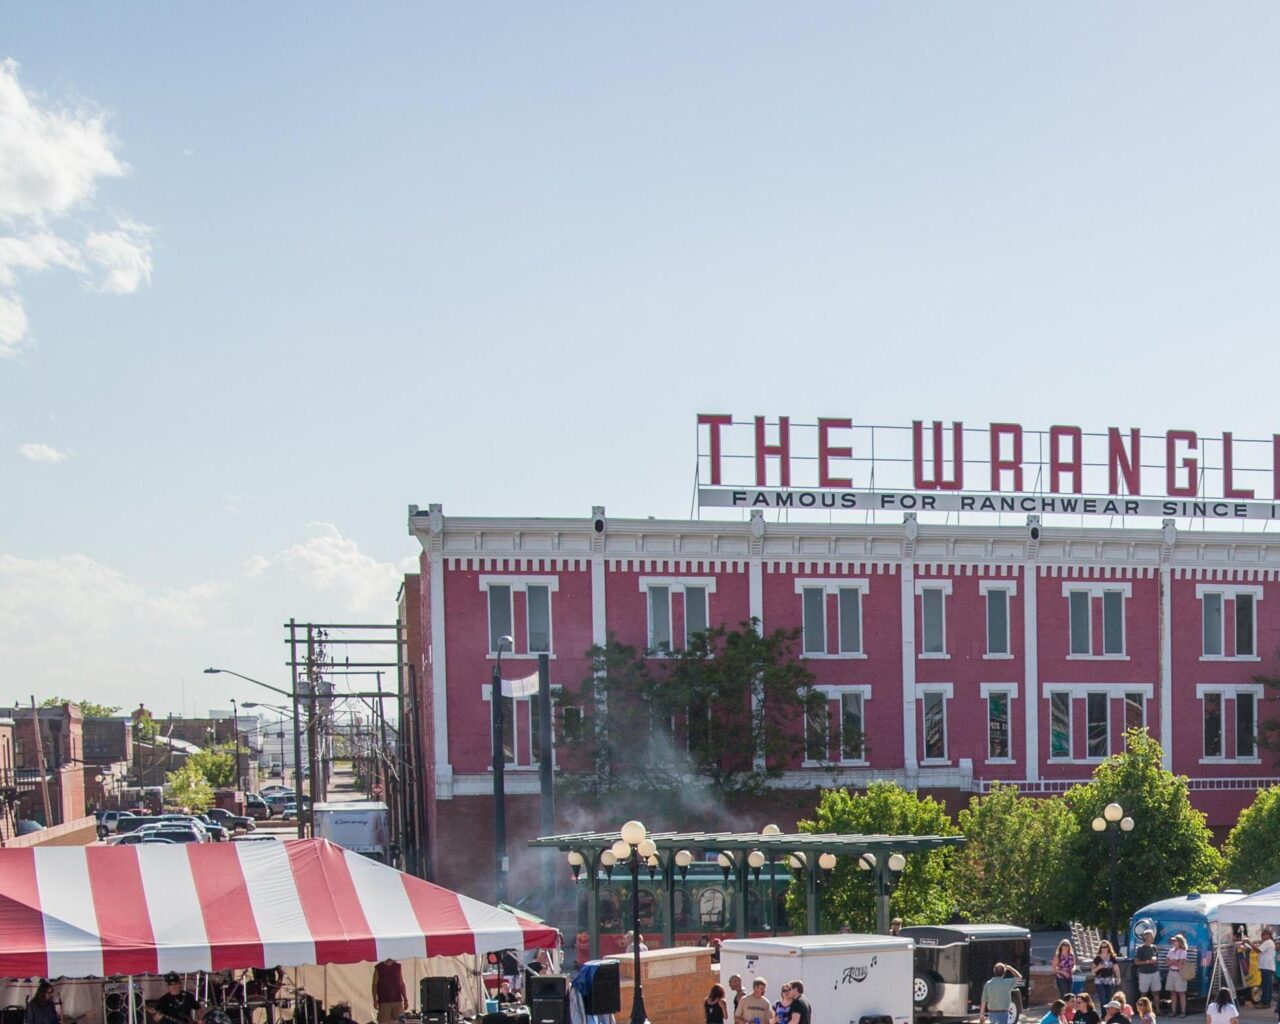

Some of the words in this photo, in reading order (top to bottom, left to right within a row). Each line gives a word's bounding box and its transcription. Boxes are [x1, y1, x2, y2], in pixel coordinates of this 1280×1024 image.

[697, 413, 852, 488] THE
[732, 490, 857, 508] FAMOUS
[880, 494, 937, 510] FOR
[961, 495, 1140, 515] RANCHWEAR
[1162, 501, 1248, 518] SINCE
